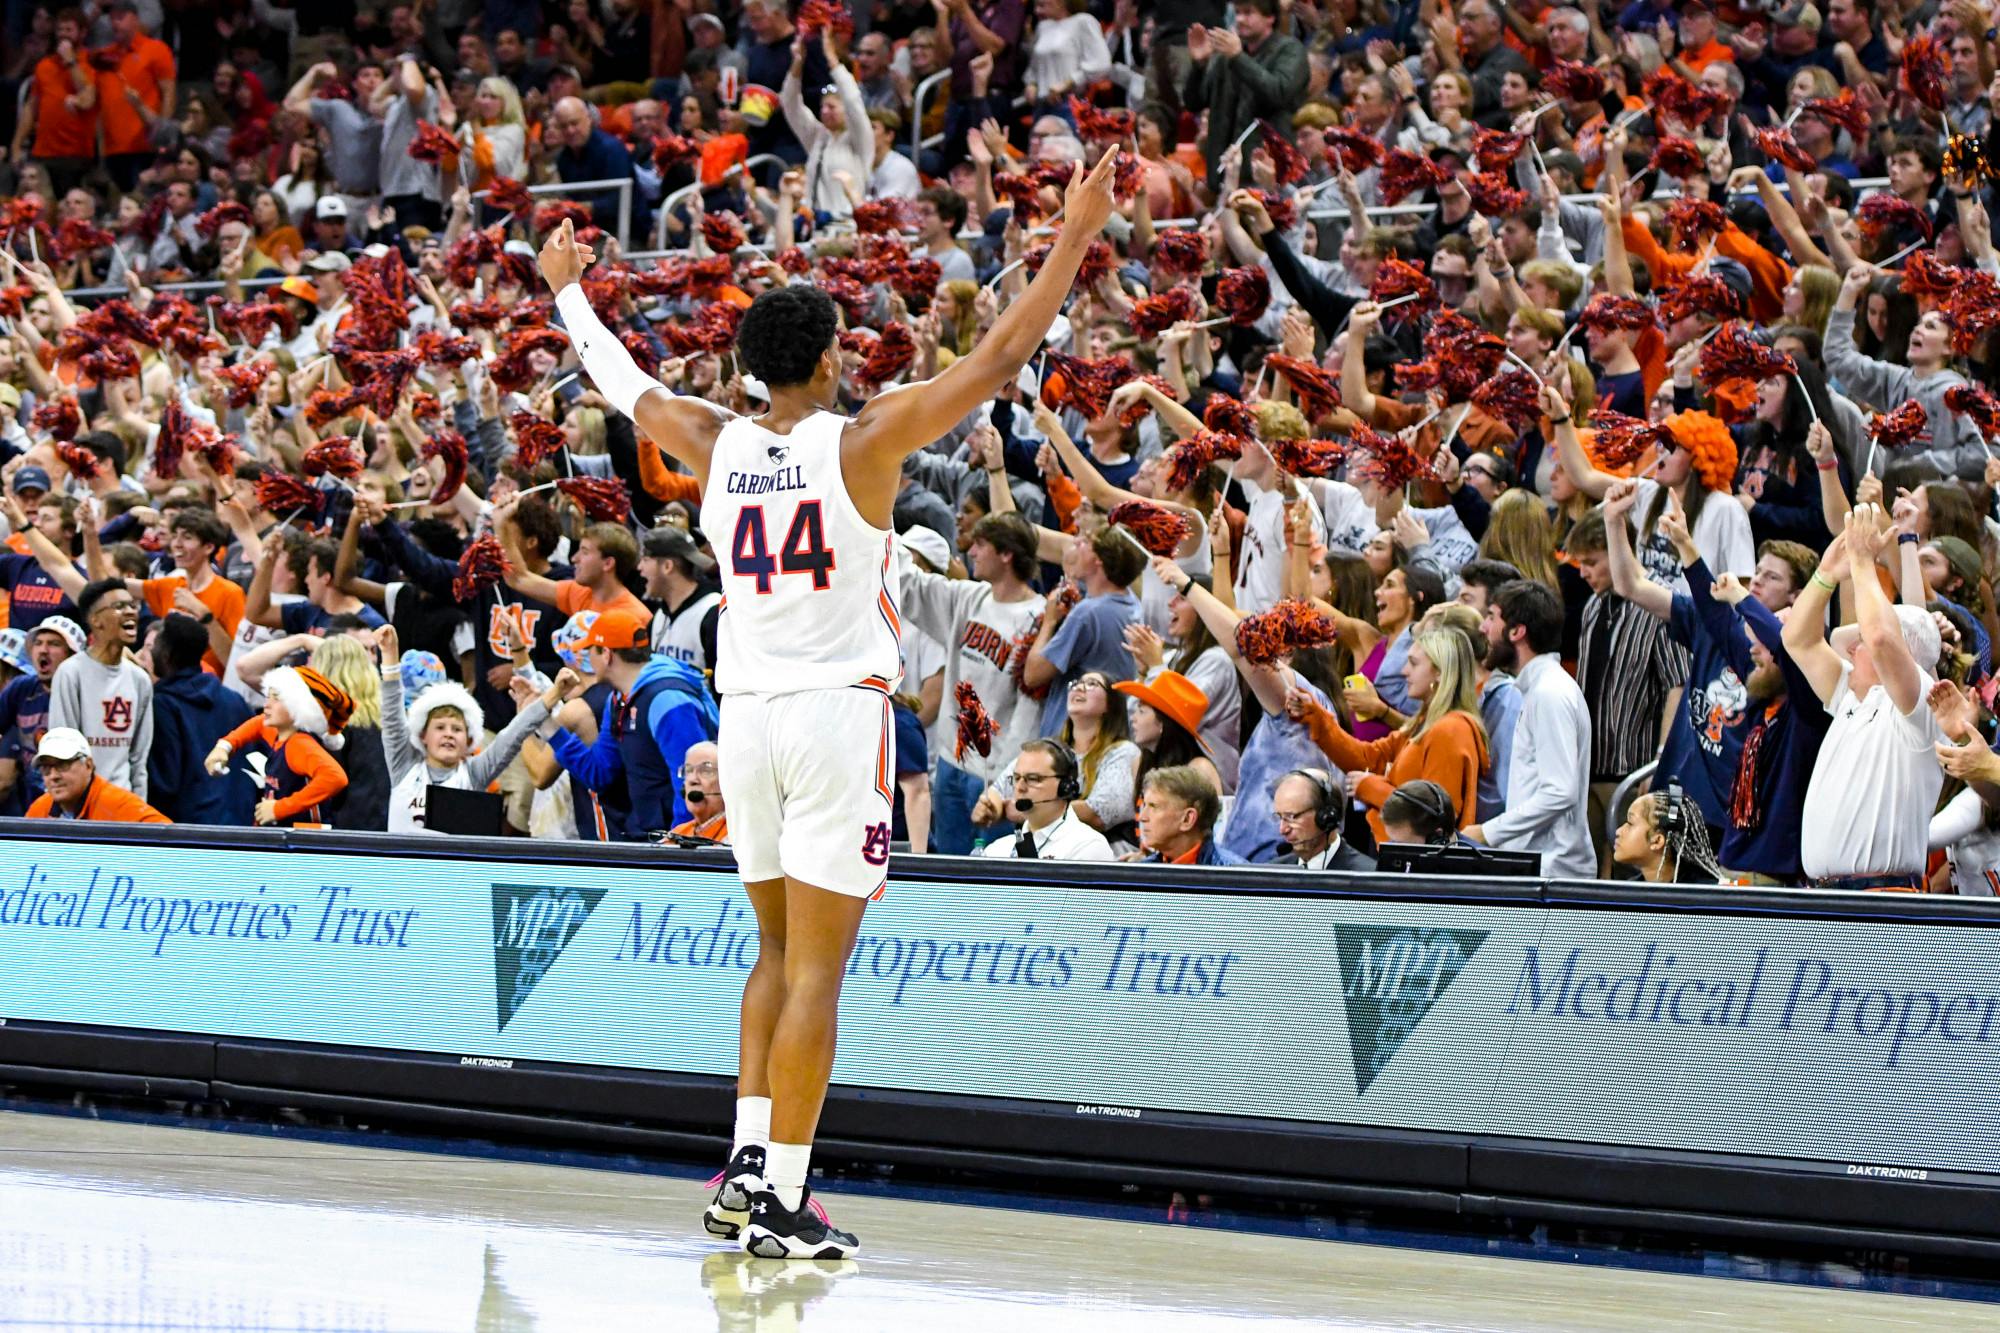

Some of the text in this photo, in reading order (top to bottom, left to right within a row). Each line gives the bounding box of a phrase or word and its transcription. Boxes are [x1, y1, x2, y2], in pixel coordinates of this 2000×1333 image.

[727, 465, 807, 494] CARDWELL
[731, 499, 836, 594] 44
[88, 736, 131, 747] BASKET
[0, 864, 420, 957] dical Properties Trust
[496, 897, 586, 949] MPT
[613, 898, 1240, 1005] Medic roperties Trust
[1348, 940, 1461, 999] MPT
[1504, 940, 2000, 1068] Medical Proper
[460, 1056, 514, 1069] DAKTRONICS
[1076, 1104, 1142, 1118] DAKTRONICS
[1846, 1164, 1928, 1180] DAKTRONICS
